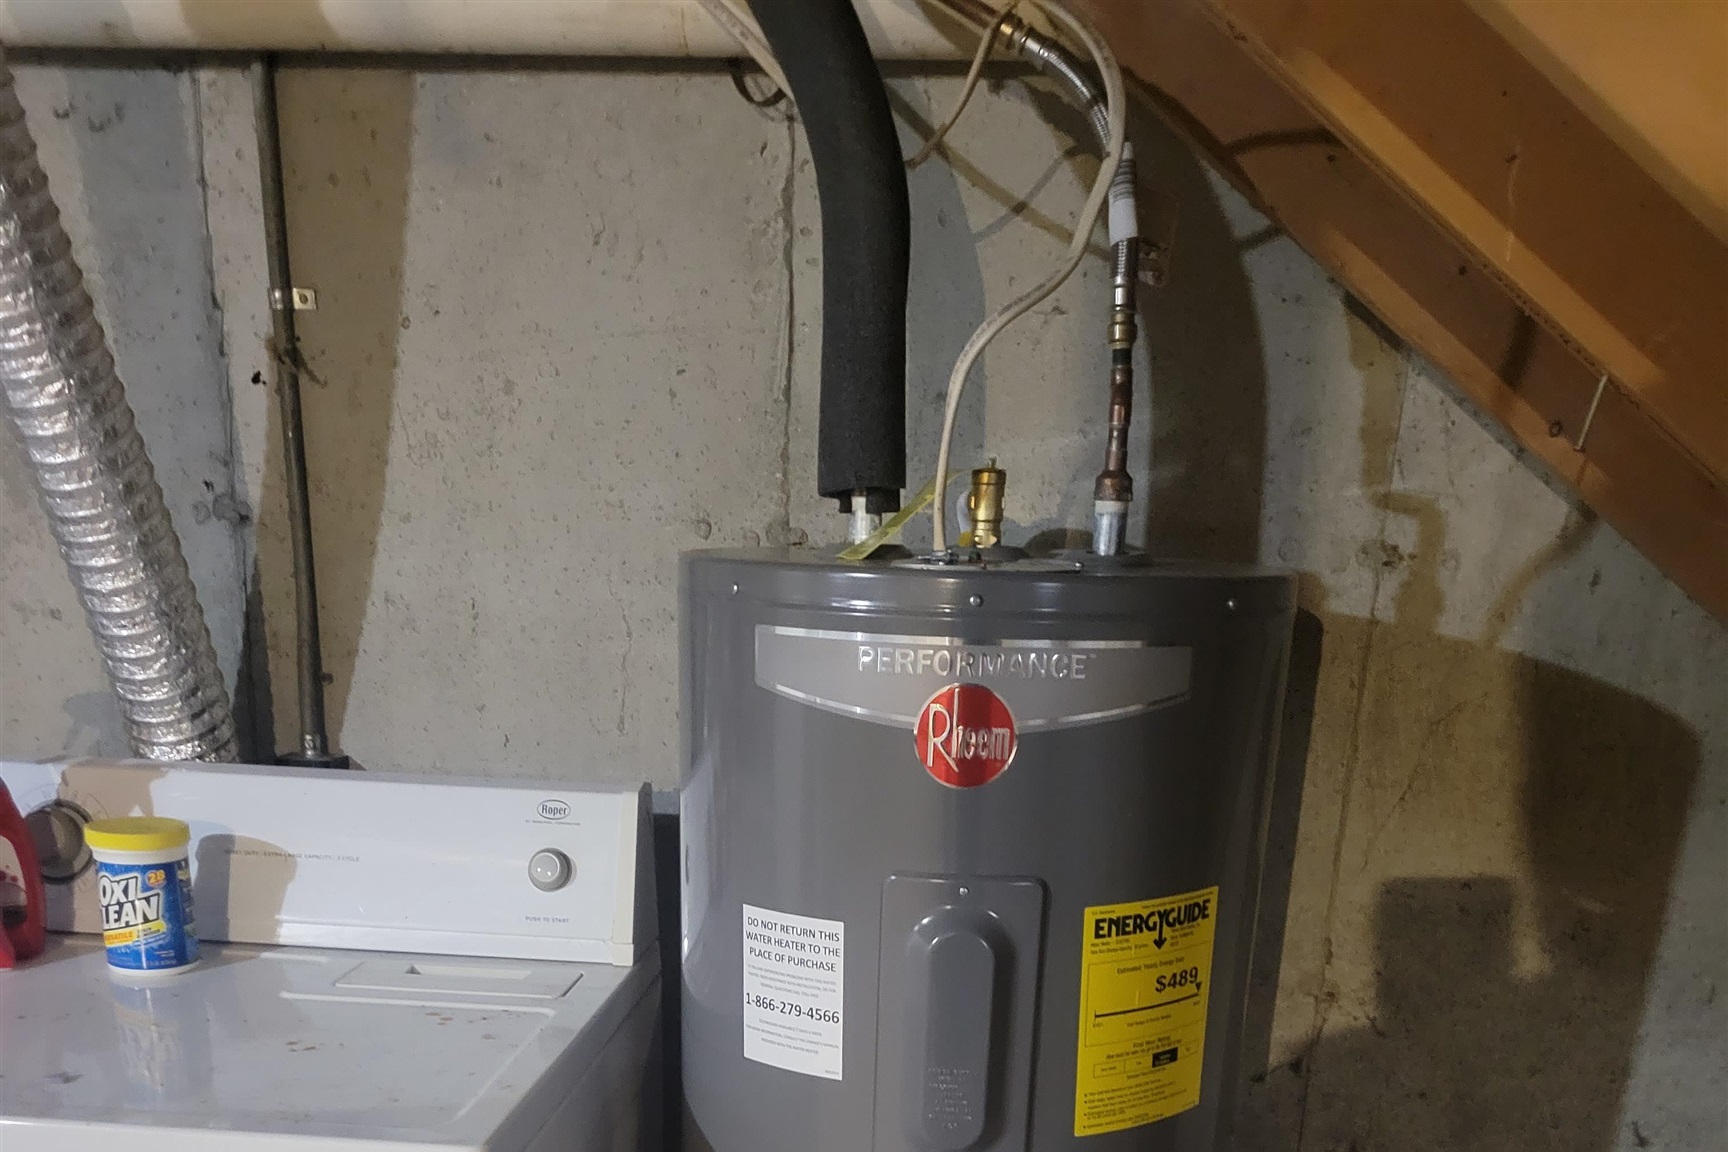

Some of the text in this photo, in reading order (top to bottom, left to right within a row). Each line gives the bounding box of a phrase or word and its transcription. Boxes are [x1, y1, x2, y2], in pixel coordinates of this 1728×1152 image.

[858, 645, 1087, 680] PERFORMANCE
[926, 687, 1012, 773] Rheem
[541, 804, 567, 816] Roper
[100, 876, 138, 906] OXI
[102, 894, 159, 928] LEAN
[1094, 898, 1211, 942] ENERGYGUIDE
[745, 930, 841, 958] WATER HEATER TO THE
[747, 916, 840, 942] DO NOT RETURN THIS
[749, 946, 837, 973] PLACE OF PURCHASE
[1155, 966, 1199, 994] $489
[745, 992, 840, 1024] 1-866-279-4566
